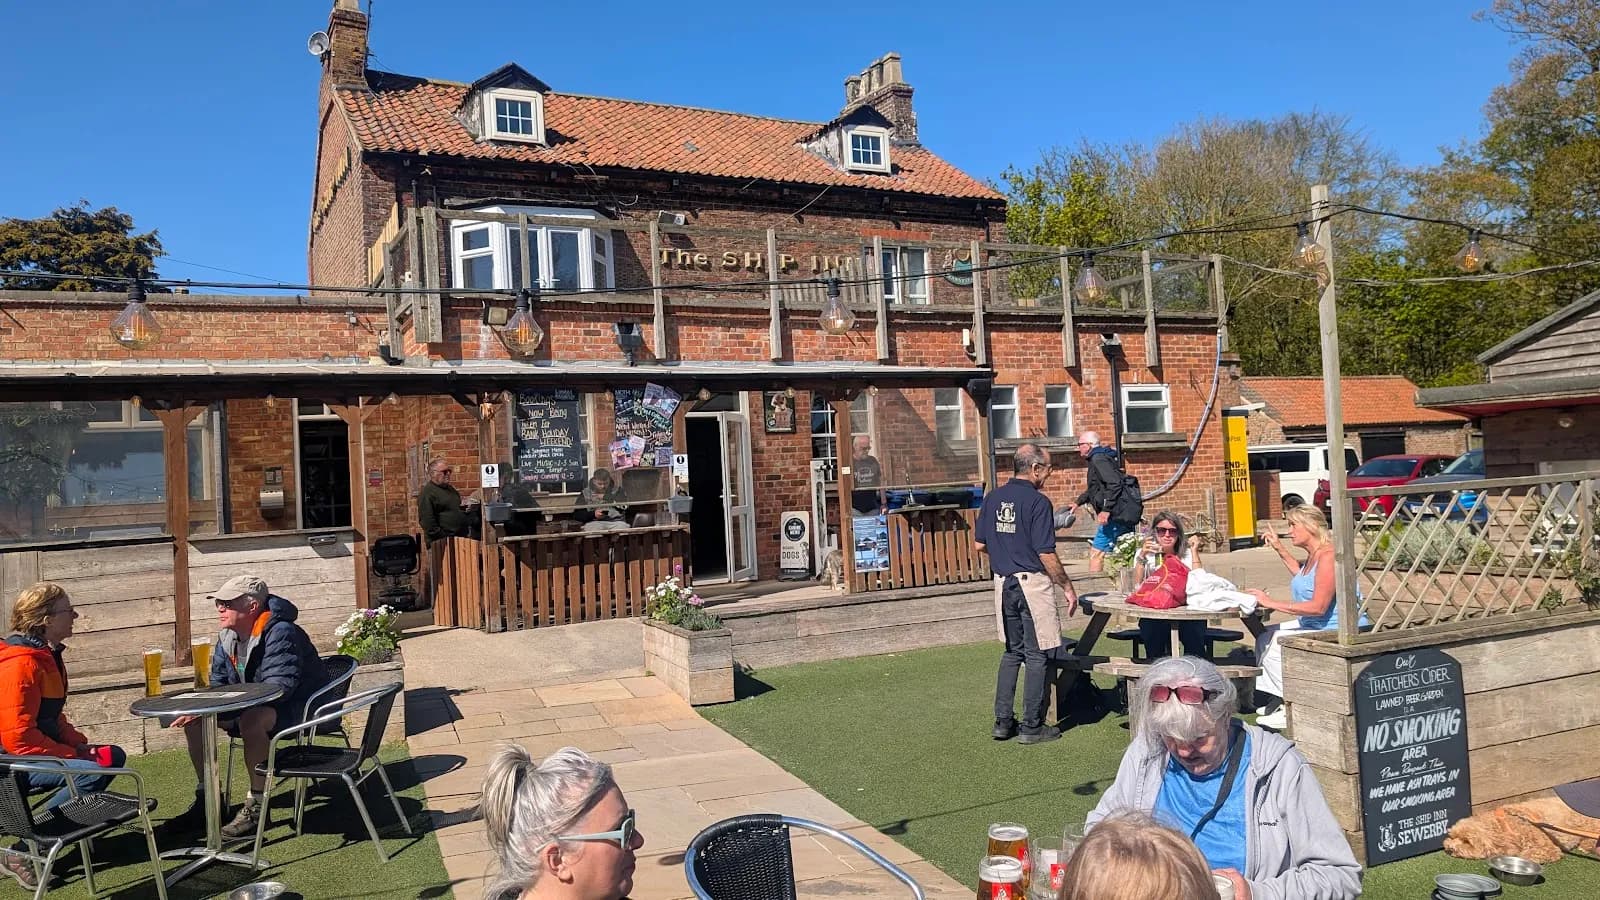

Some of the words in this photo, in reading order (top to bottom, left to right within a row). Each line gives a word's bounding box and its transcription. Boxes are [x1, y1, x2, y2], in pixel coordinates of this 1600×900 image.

[660, 248, 708, 267] The
[722, 251, 796, 271] SHP
[782, 551, 799, 560] DOGS
[1369, 673, 1420, 695] THATCHERS
[1376, 697, 1404, 711] LAWNED
[1405, 693, 1420, 705] BEER
[1421, 689, 1444, 702] GARDEN
[1363, 722, 1390, 752] NO
[1391, 708, 1461, 747] SMOKING
[1401, 745, 1428, 761] AREA
[1369, 786, 1384, 799] WE
[1384, 781, 1406, 796] HAVE
[1406, 777, 1422, 791] ASH
[1422, 771, 1447, 787] TRAYS
[1448, 768, 1460, 781] IN
[1382, 798, 1400, 813] OUR
[1400, 791, 1435, 809] SMOKING
[1435, 786, 1456, 801] AREA
[1398, 817, 1414, 830] THE
[1415, 813, 1432, 826] SHIP
[1433, 808, 1447, 821] INN
[1397, 819, 1449, 846] SEWERBY
